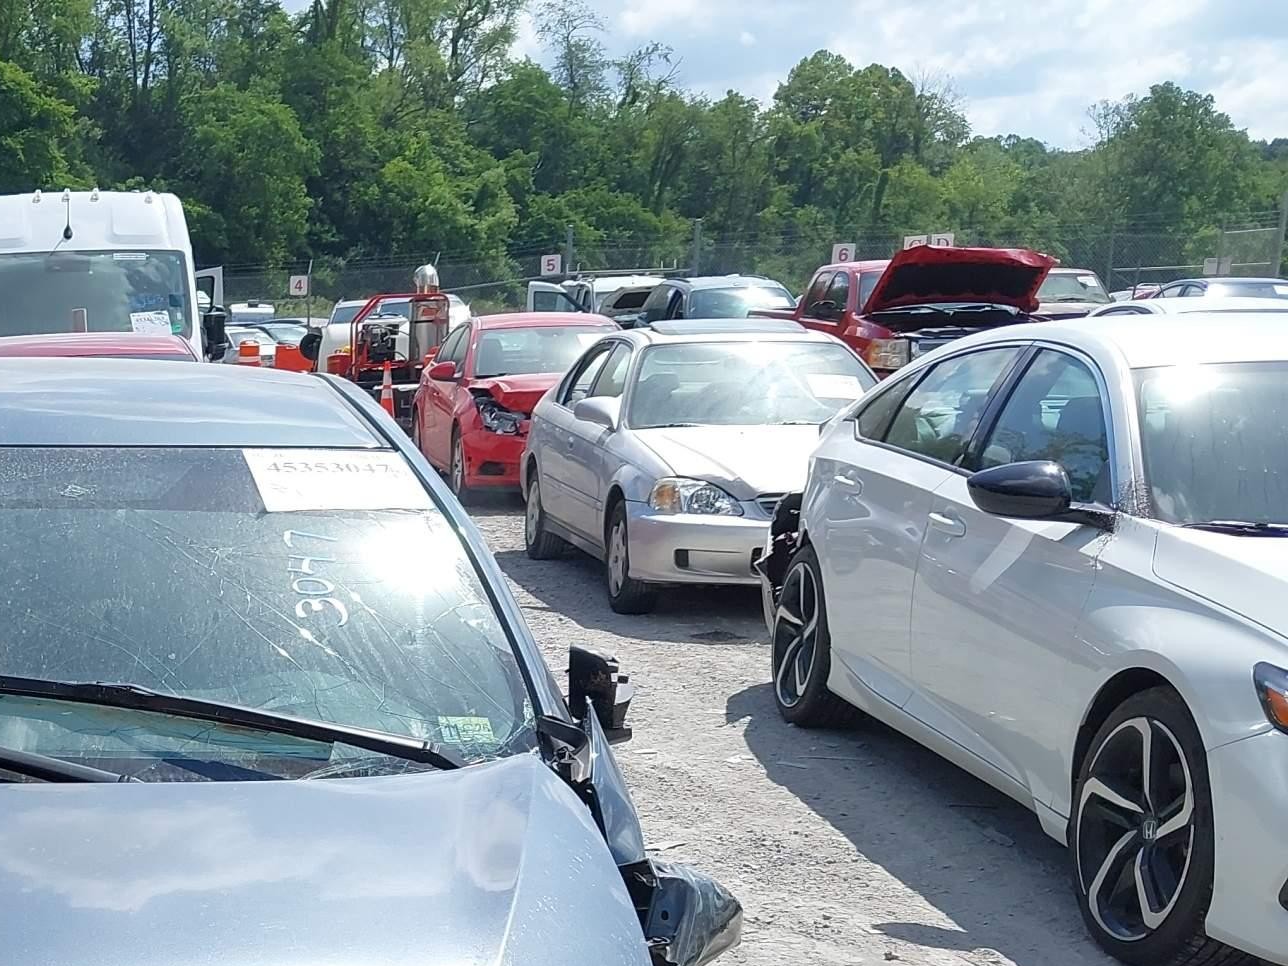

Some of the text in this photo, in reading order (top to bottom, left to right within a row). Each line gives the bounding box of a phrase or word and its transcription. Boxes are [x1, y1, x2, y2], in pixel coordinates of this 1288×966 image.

[838, 248, 849, 262] 6
[546, 258, 556, 272] 5
[294, 279, 304, 292] 4
[266, 461, 389, 473] 45353047
[283, 529, 349, 628] 3047
